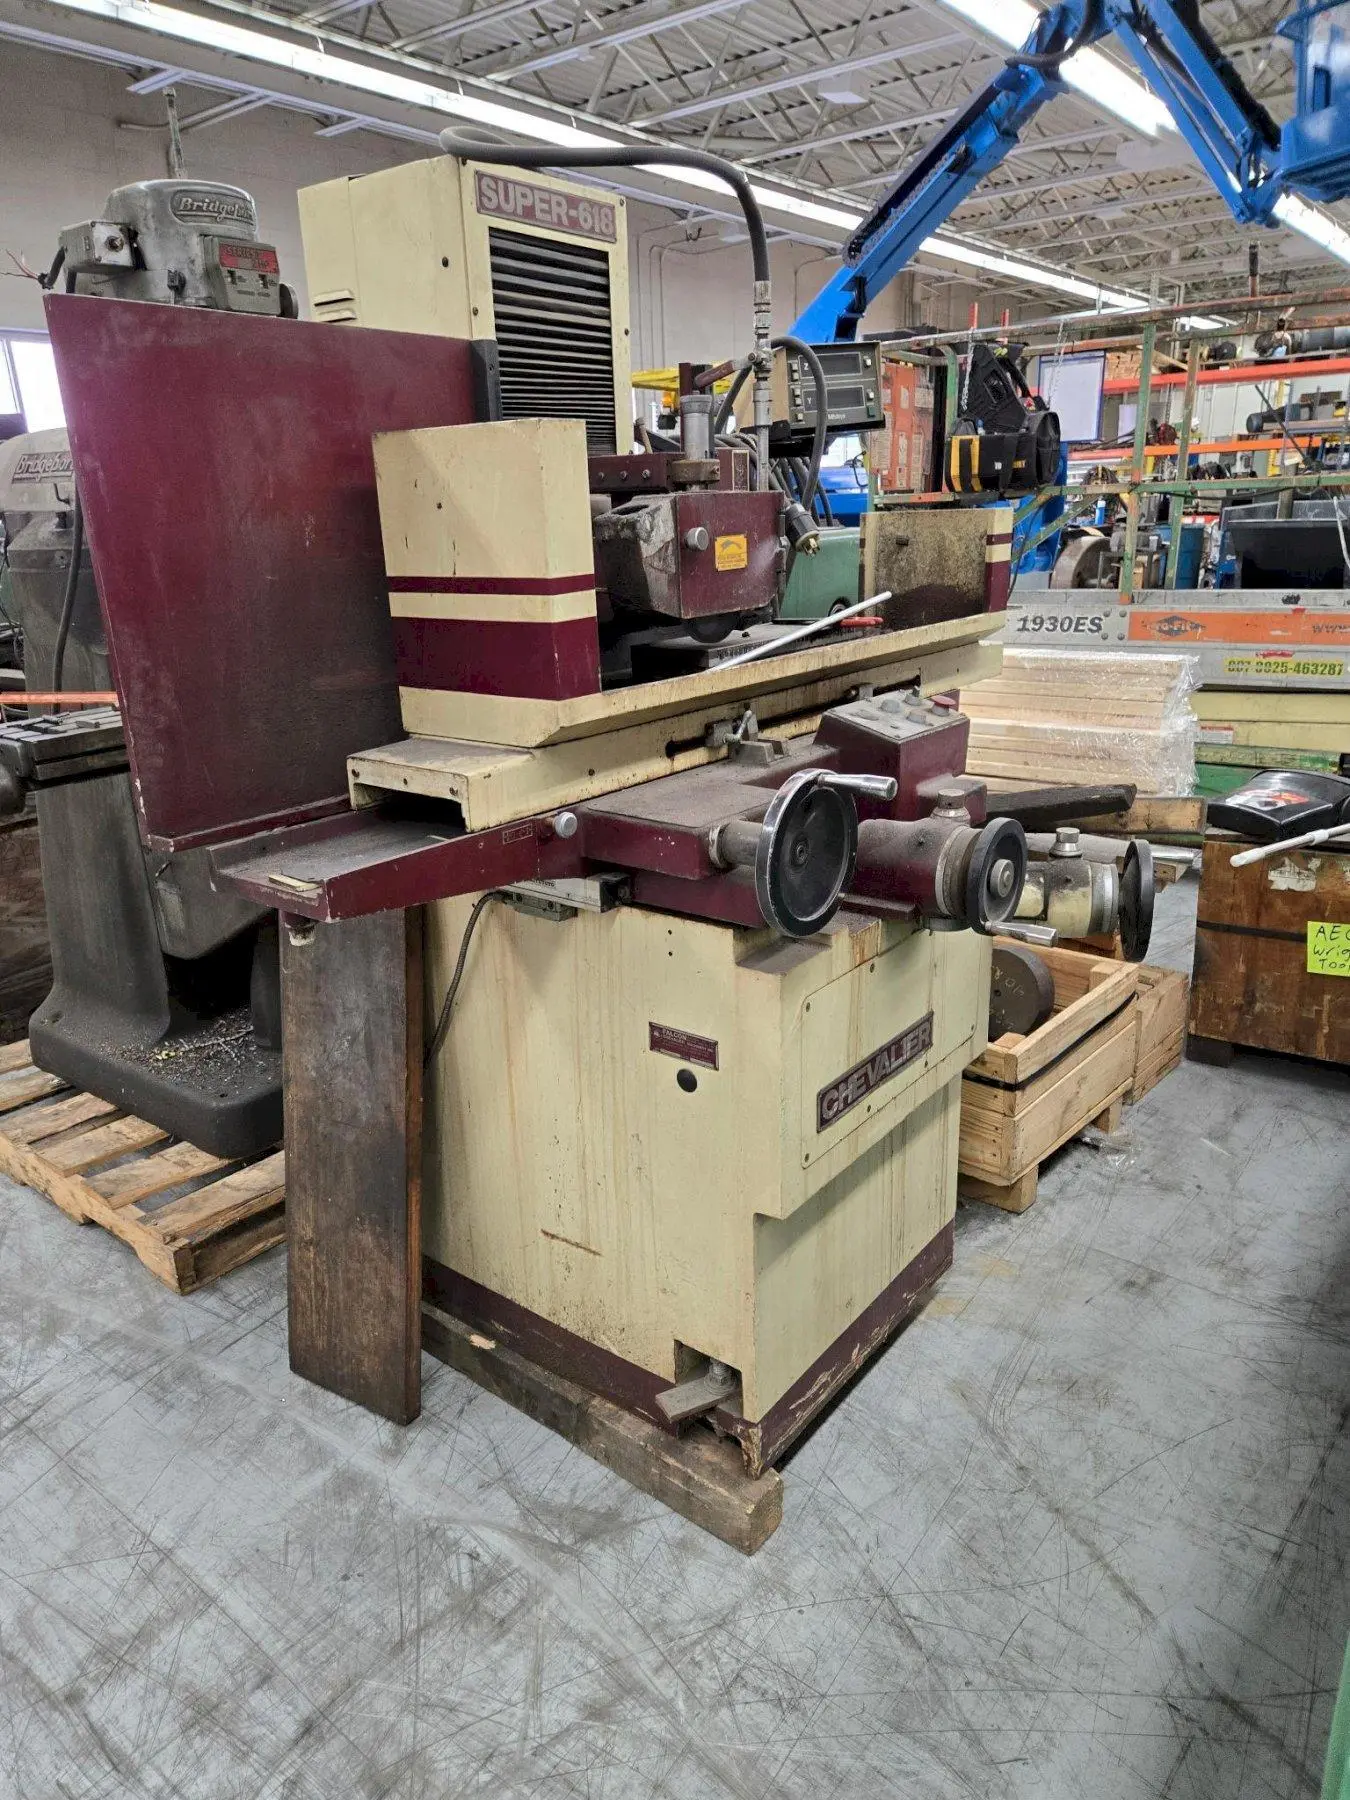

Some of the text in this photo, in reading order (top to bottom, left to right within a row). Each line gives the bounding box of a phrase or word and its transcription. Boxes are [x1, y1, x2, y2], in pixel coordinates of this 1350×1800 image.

[480, 175, 614, 235] SUPER-618
[803, 362, 809, 371] Z
[806, 397, 812, 405] Y
[17, 453, 73, 482] Bridgepor
[1016, 615, 1103, 634] 1930ES
[821, 1020, 932, 1121] CHEVALIER
